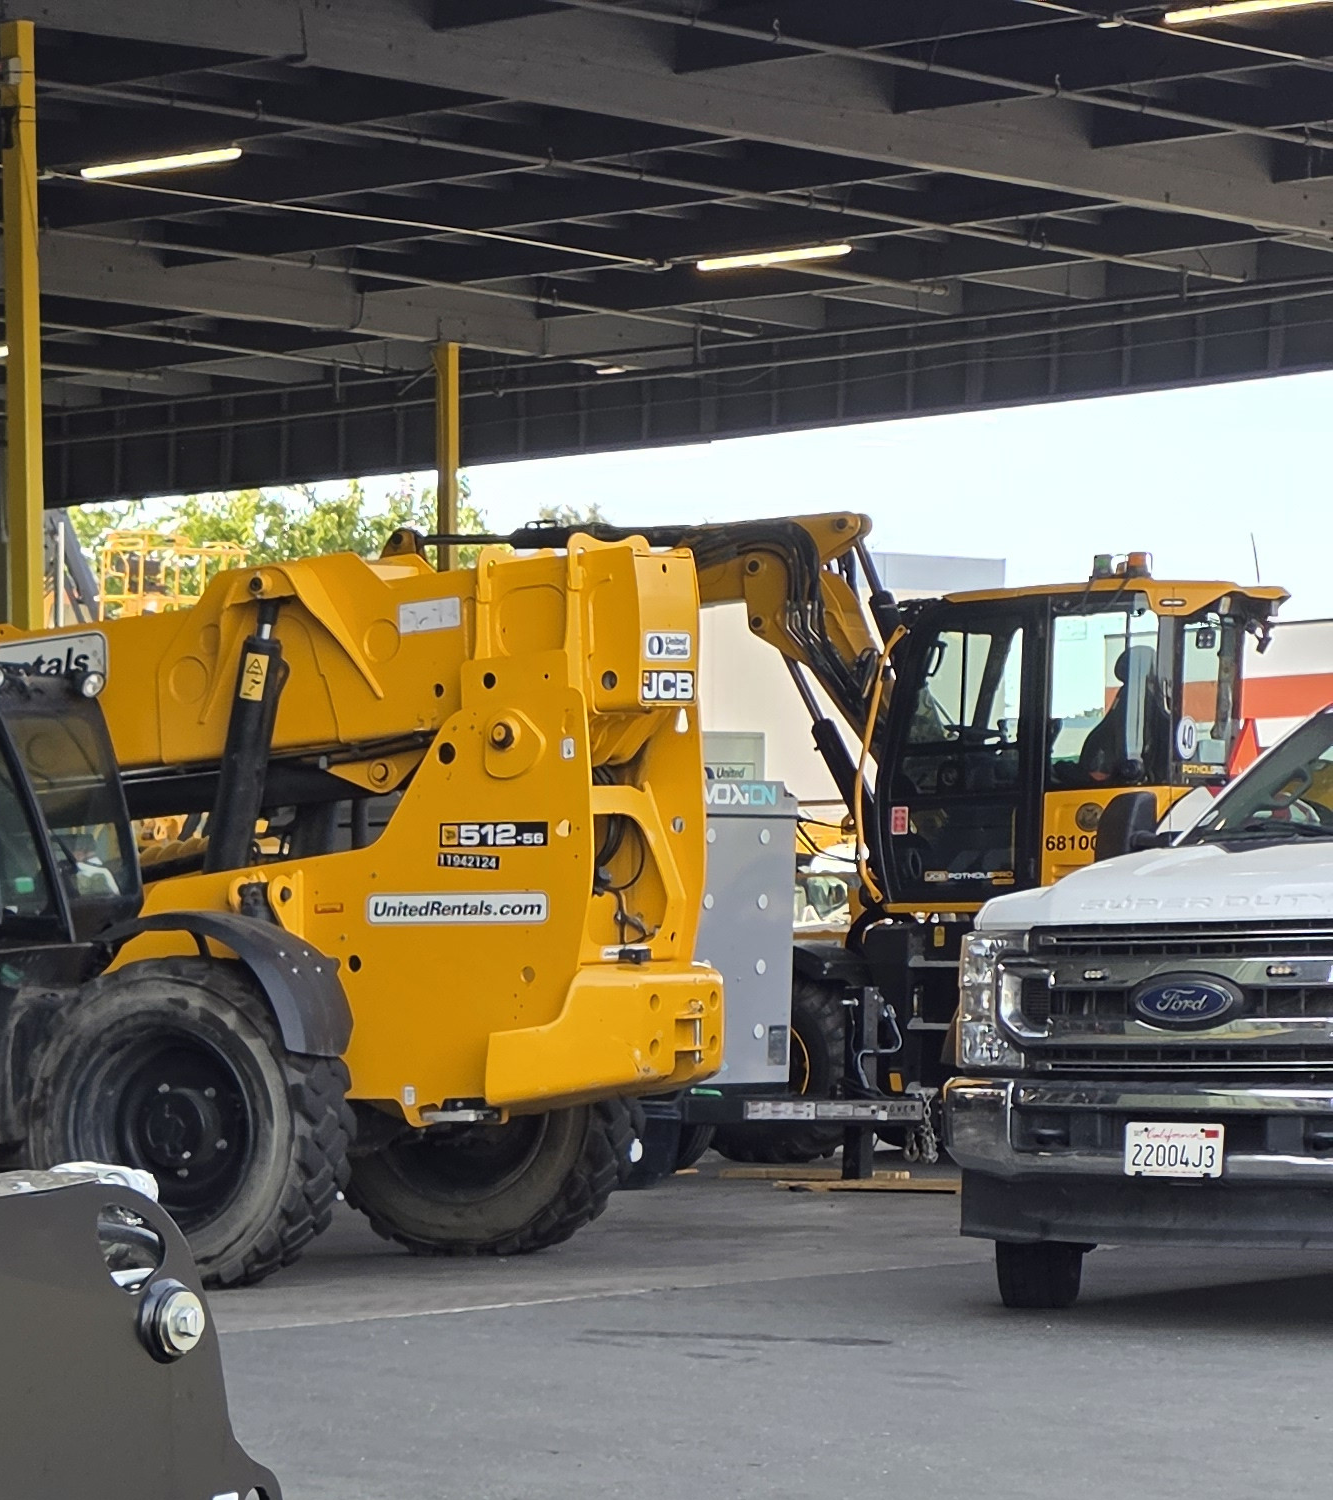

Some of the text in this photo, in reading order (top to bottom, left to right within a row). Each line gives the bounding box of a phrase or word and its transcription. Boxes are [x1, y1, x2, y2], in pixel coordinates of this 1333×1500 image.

[643, 672, 694, 699] JCB
[1182, 725, 1193, 750] 40
[439, 854, 496, 868] 11942124
[374, 900, 542, 917] UnitedRentals.com
[1081, 895, 1214, 911] SUPER
[1156, 989, 1208, 1012] Ford
[1147, 1126, 1200, 1142] California
[1132, 1143, 1215, 1168] 22004J3
